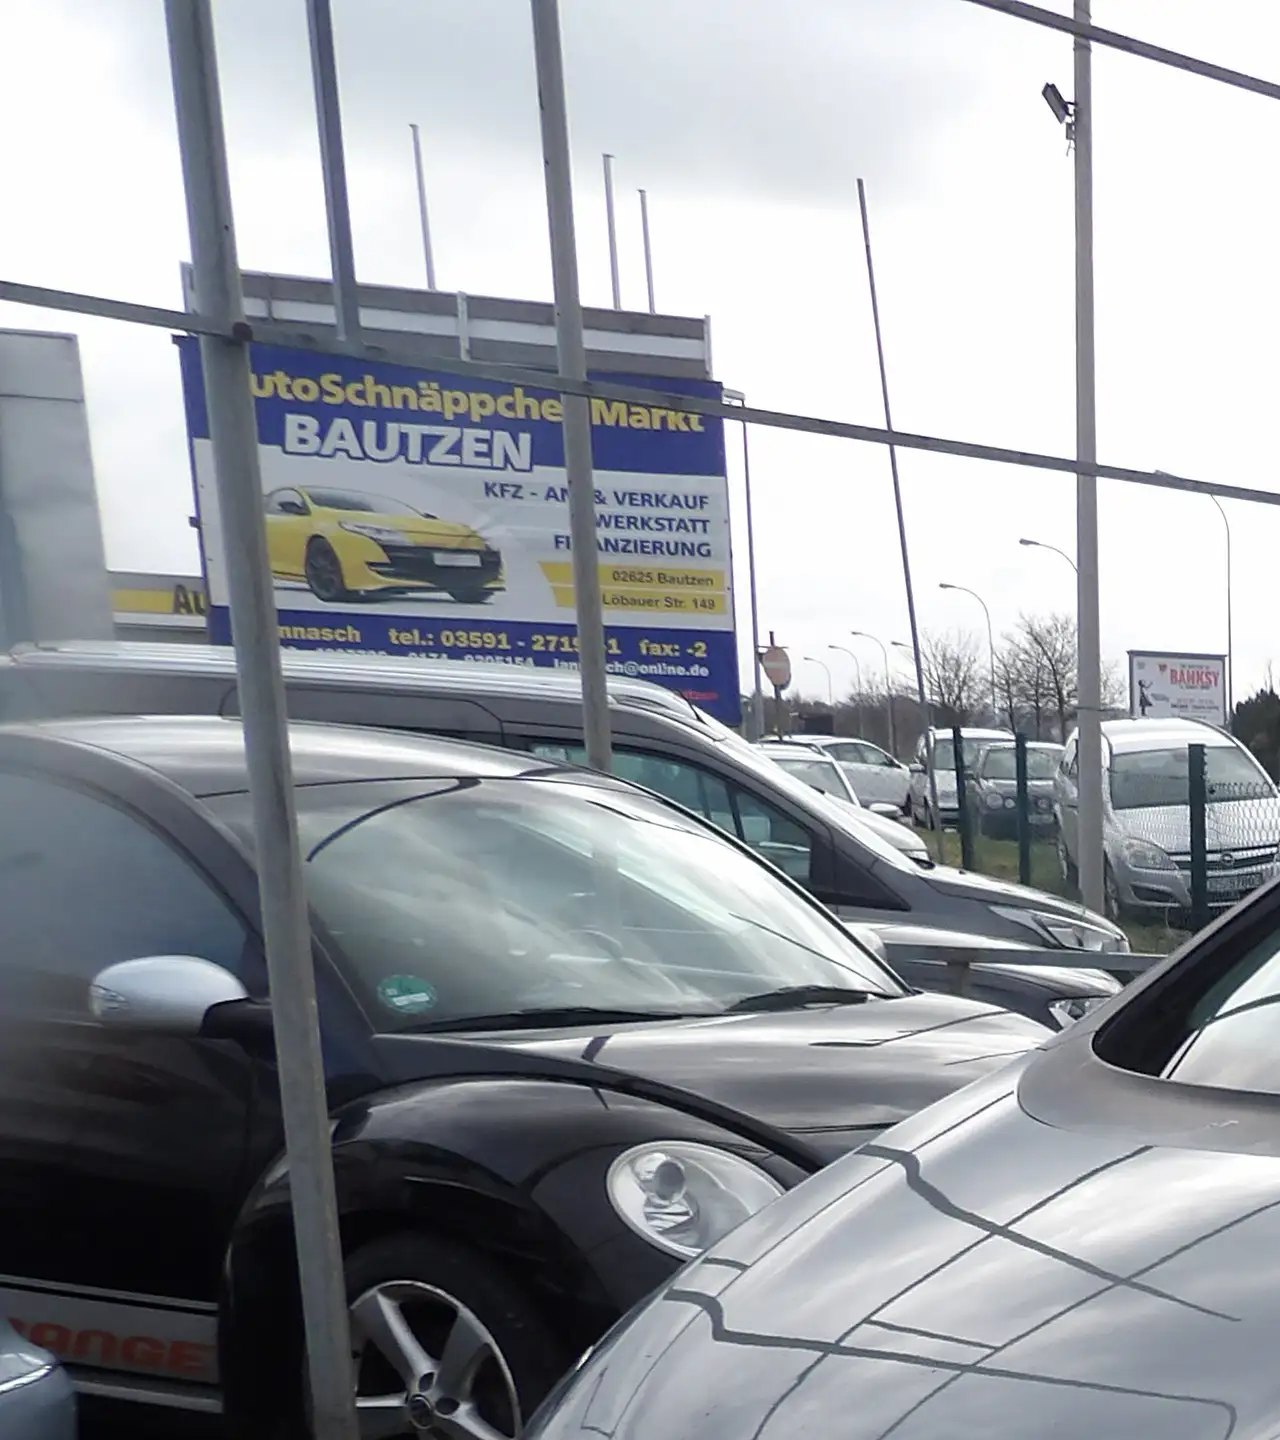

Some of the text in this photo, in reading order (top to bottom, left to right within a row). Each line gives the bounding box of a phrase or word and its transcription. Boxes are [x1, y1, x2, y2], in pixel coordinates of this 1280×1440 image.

[284, 412, 533, 471] BAUTZEN
[484, 481, 523, 500] KFZ
[595, 490, 607, 504] &
[613, 491, 709, 511] VERKAUF
[596, 514, 711, 535] WERKSTATT
[612, 570, 714, 586] 02625 Bautzen
[602, 593, 660, 607] Löbauer
[664, 597, 687, 609] Str.
[388, 628, 434, 646] tel.:
[440, 630, 512, 650] 03591
[639, 639, 680, 657] fax:
[1170, 669, 1219, 687] BANKSY
